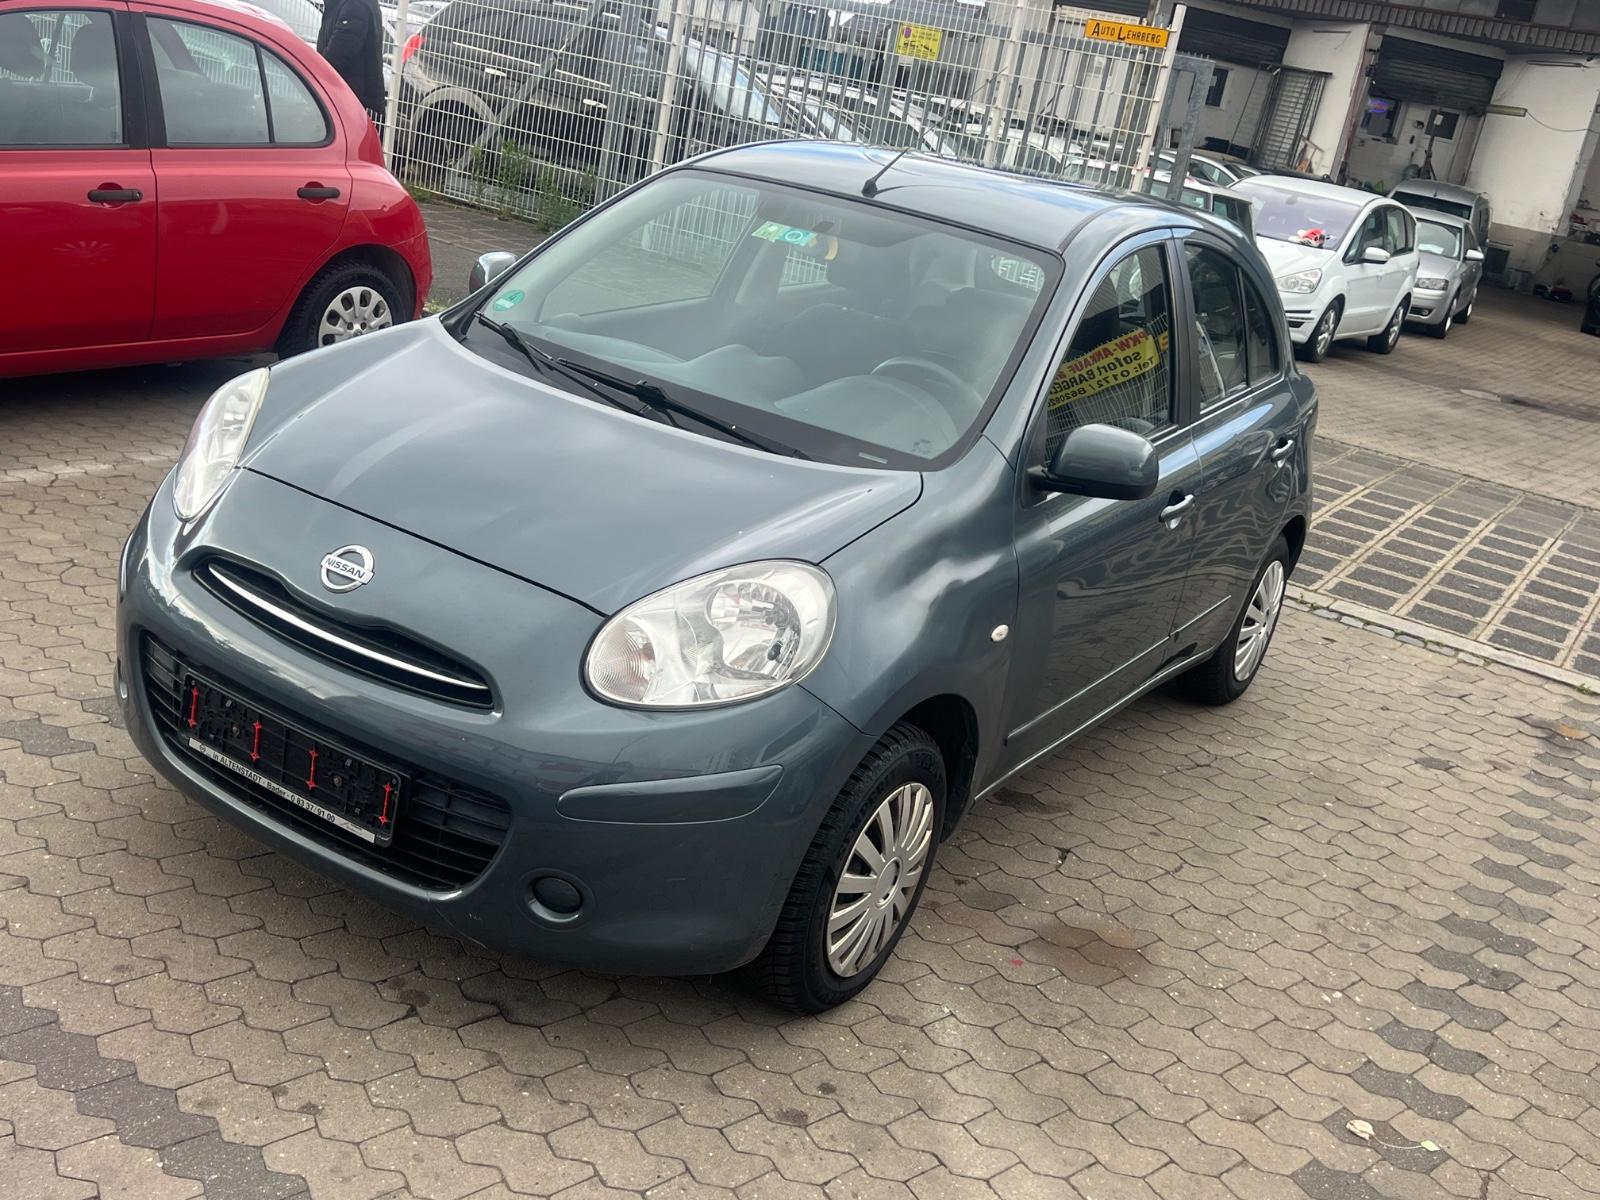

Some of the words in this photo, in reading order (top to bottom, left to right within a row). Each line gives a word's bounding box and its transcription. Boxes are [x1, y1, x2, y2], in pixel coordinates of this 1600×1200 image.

[1091, 22, 1115, 37] AUTO
[1117, 26, 1161, 44] LEHRBERG
[325, 557, 366, 579] NISSAN
[220, 757, 262, 783] ALTENSTADT
[266, 781, 286, 798] Bader
